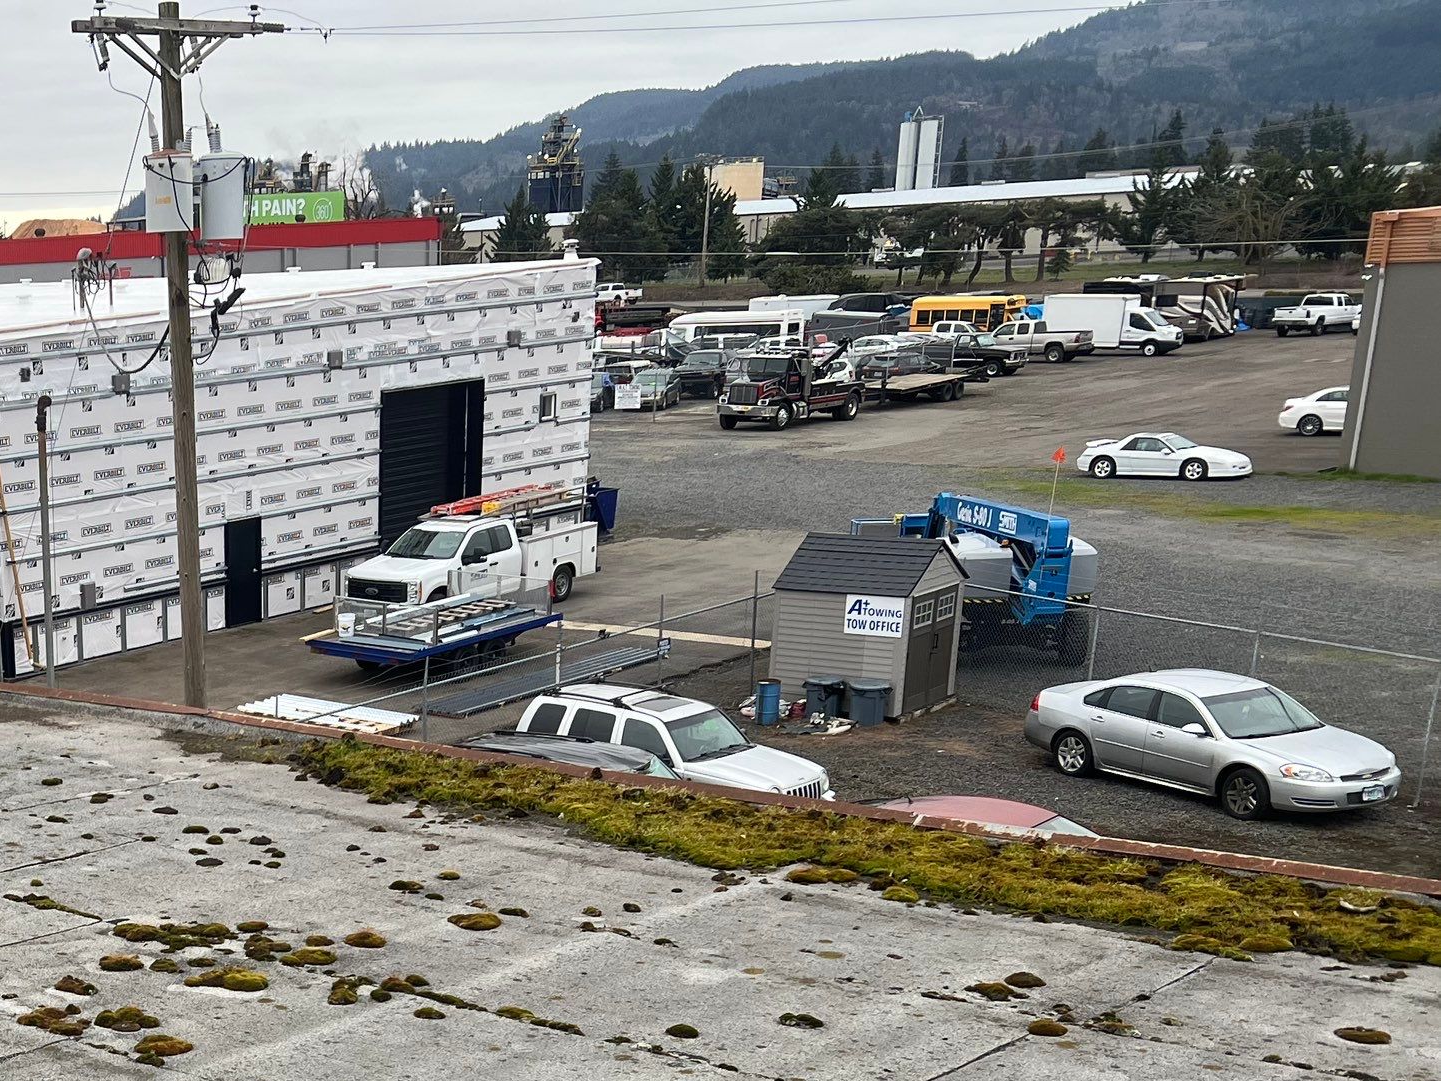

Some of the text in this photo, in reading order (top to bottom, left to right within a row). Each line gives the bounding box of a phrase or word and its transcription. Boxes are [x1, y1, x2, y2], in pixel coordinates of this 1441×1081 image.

[262, 198, 306, 217] PAIN?
[43, 341, 73, 350] EVERBILT
[72, 426, 100, 437] EVERBILT
[95, 468, 123, 479] EVERBILT
[51, 475, 79, 486] EVERBILT
[5, 482, 34, 493] EVERBILT
[847, 599, 902, 618] A+ TOWING
[847, 619, 900, 633] TOW OFFICE
